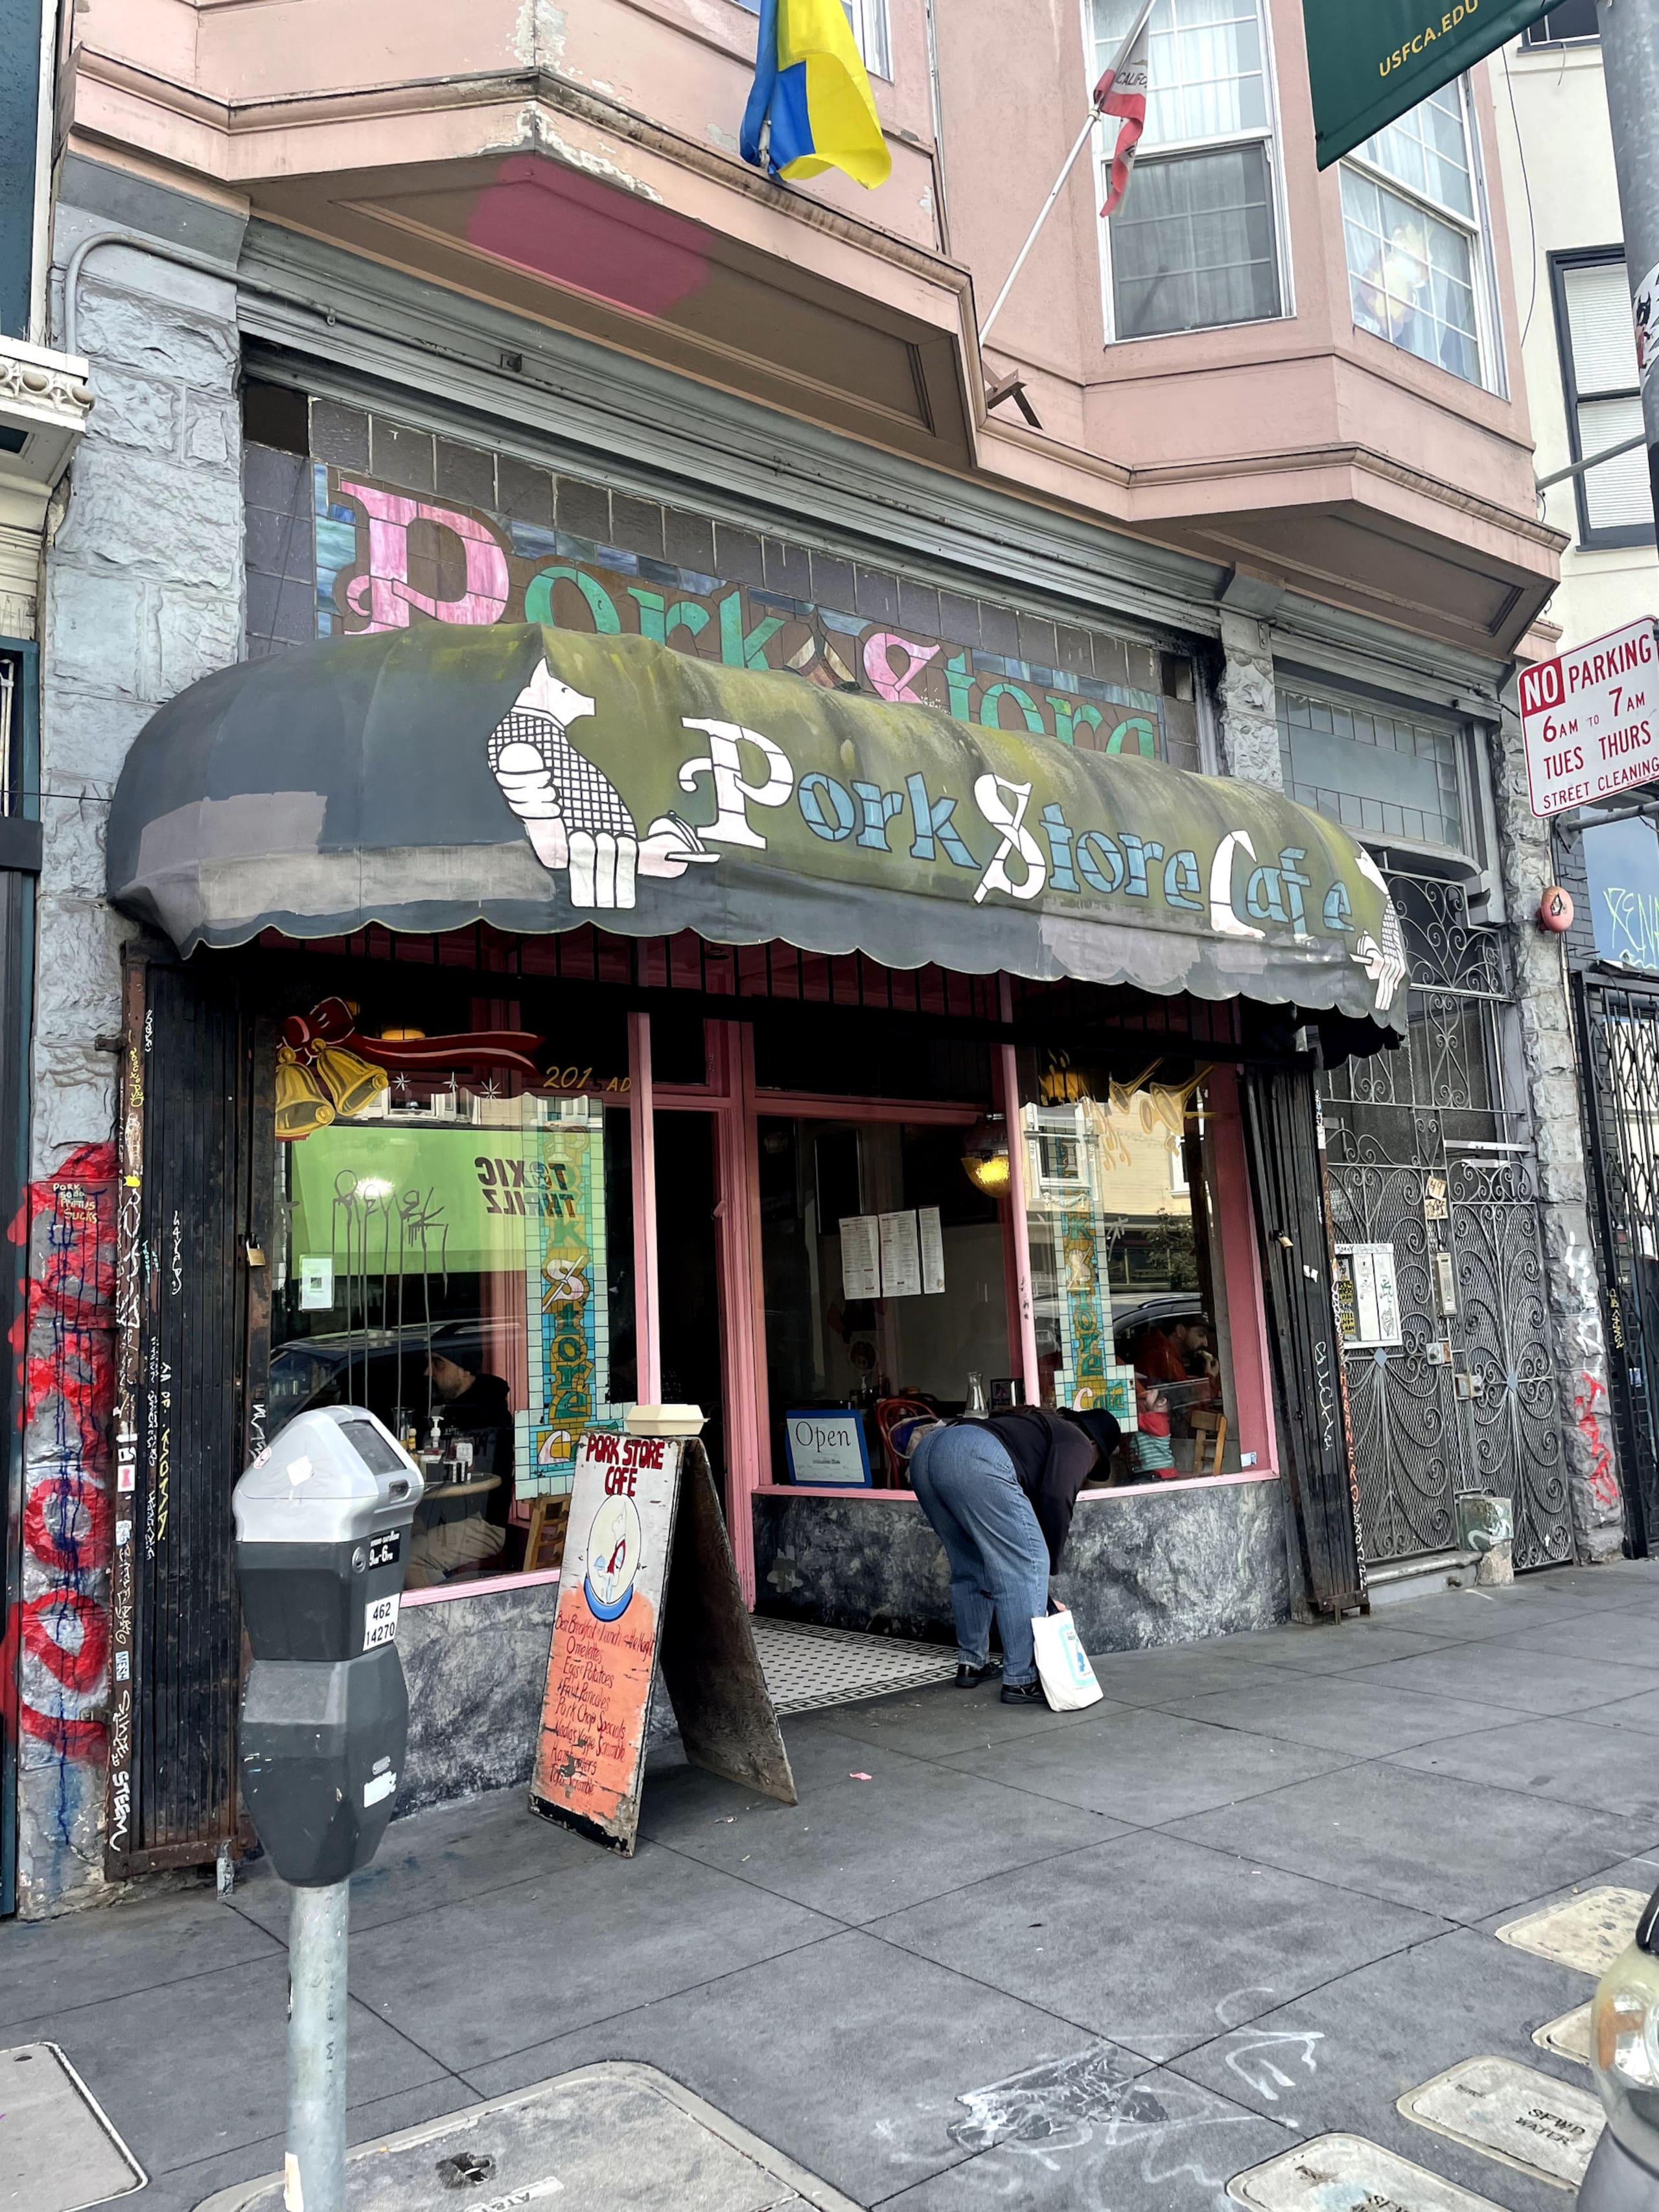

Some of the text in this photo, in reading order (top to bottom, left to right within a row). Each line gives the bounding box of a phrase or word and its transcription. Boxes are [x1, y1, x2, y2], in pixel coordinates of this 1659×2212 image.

[1378, 0, 1479, 77] USFCA.EDU
[341, 480, 785, 671] Pork
[1524, 634, 1651, 711] NO PARKING
[1588, 714, 1599, 727] TO
[1544, 721, 1651, 780] TUES THURS
[1544, 782, 1590, 809] STREET
[1597, 756, 1659, 792] CLEANING
[678, 716, 1355, 944] Pork Store Cafe
[606, 1077, 632, 1092] AD
[52, 1183, 80, 1191] PORK
[64, 1208, 98, 1224] SUCKS
[586, 1434, 620, 1465] PORK
[622, 1439, 665, 1470] STORE
[796, 1421, 851, 1453] Open
[605, 1466, 638, 1496] CAFE
[373, 1601, 391, 1620] 462
[367, 1622, 395, 1646] 14270
[555, 1696, 576, 1722] Pork
